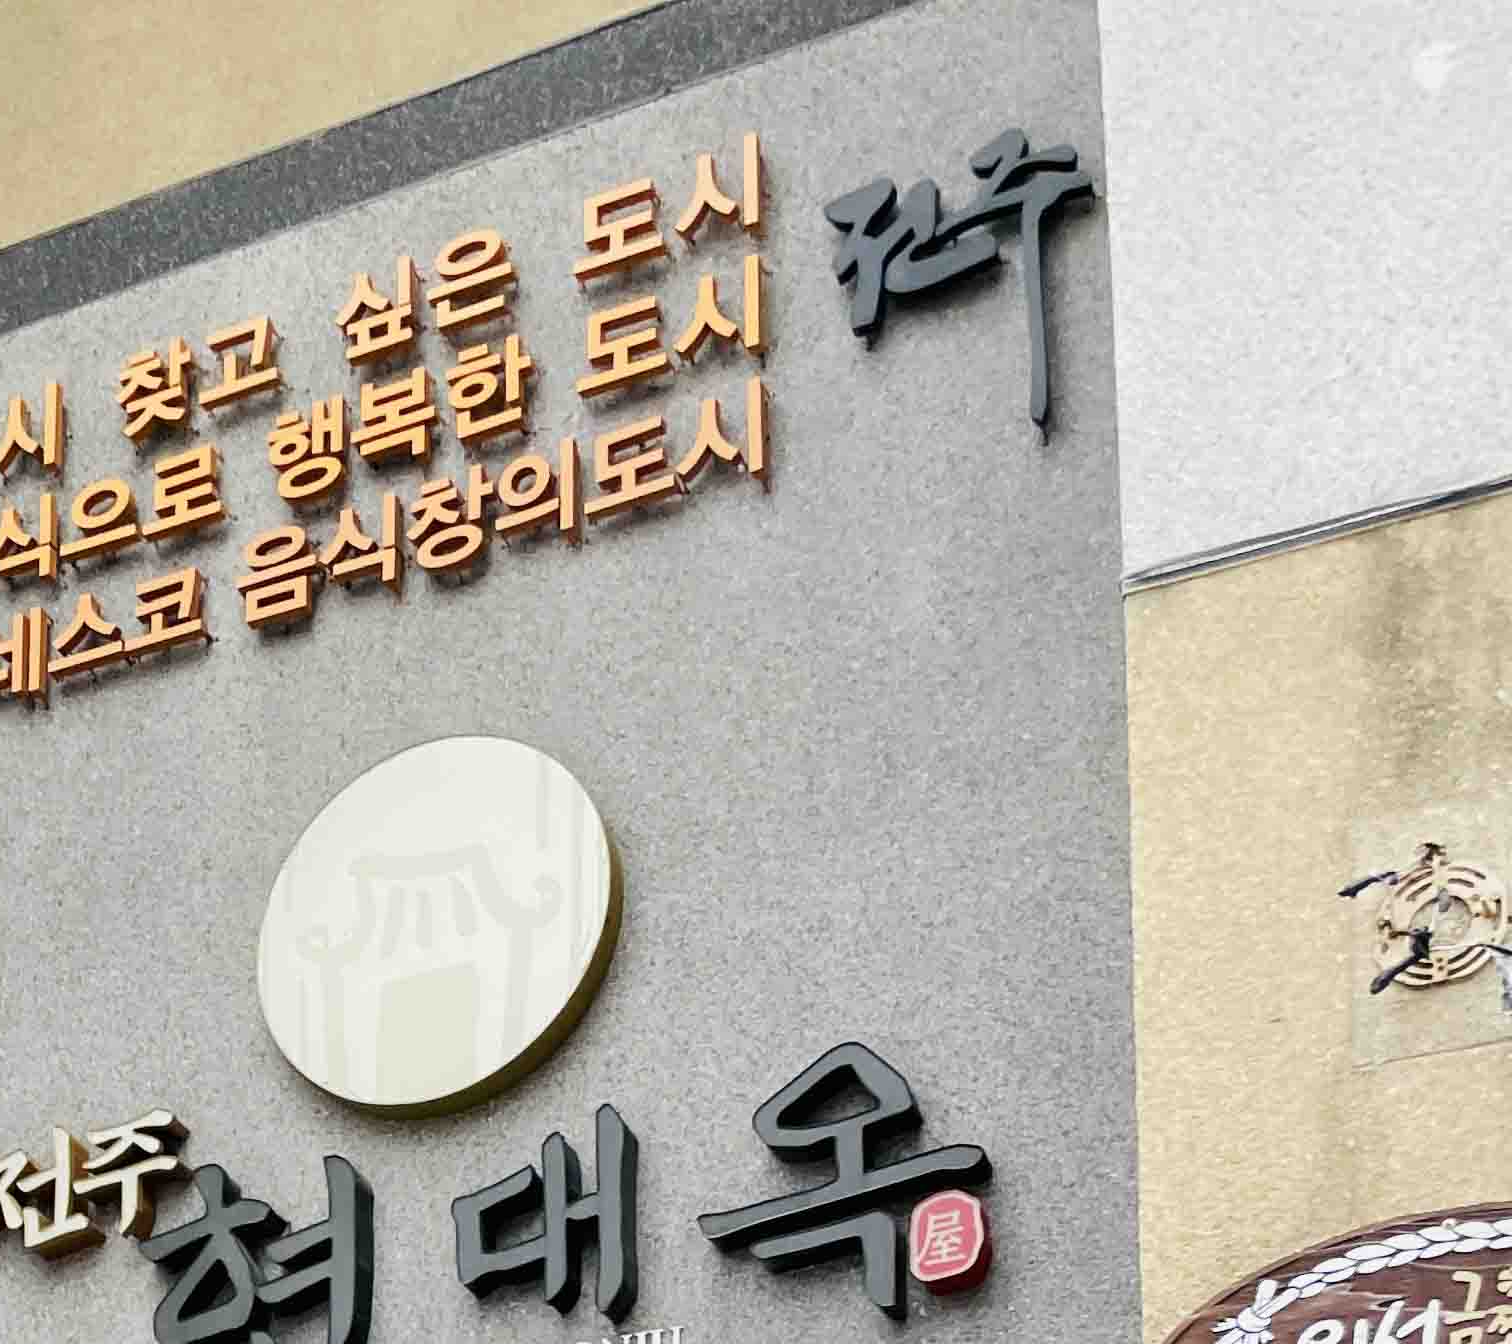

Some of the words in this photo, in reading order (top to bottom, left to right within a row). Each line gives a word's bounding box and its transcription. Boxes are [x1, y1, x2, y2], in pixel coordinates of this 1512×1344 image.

[118, 314, 285, 443] 찾고
[336, 228, 514, 367] 싶은
[572, 132, 769, 289] 도시
[268, 336, 534, 504] 행복한
[576, 253, 769, 398] 도시
[235, 375, 773, 628] 음식창의도시
